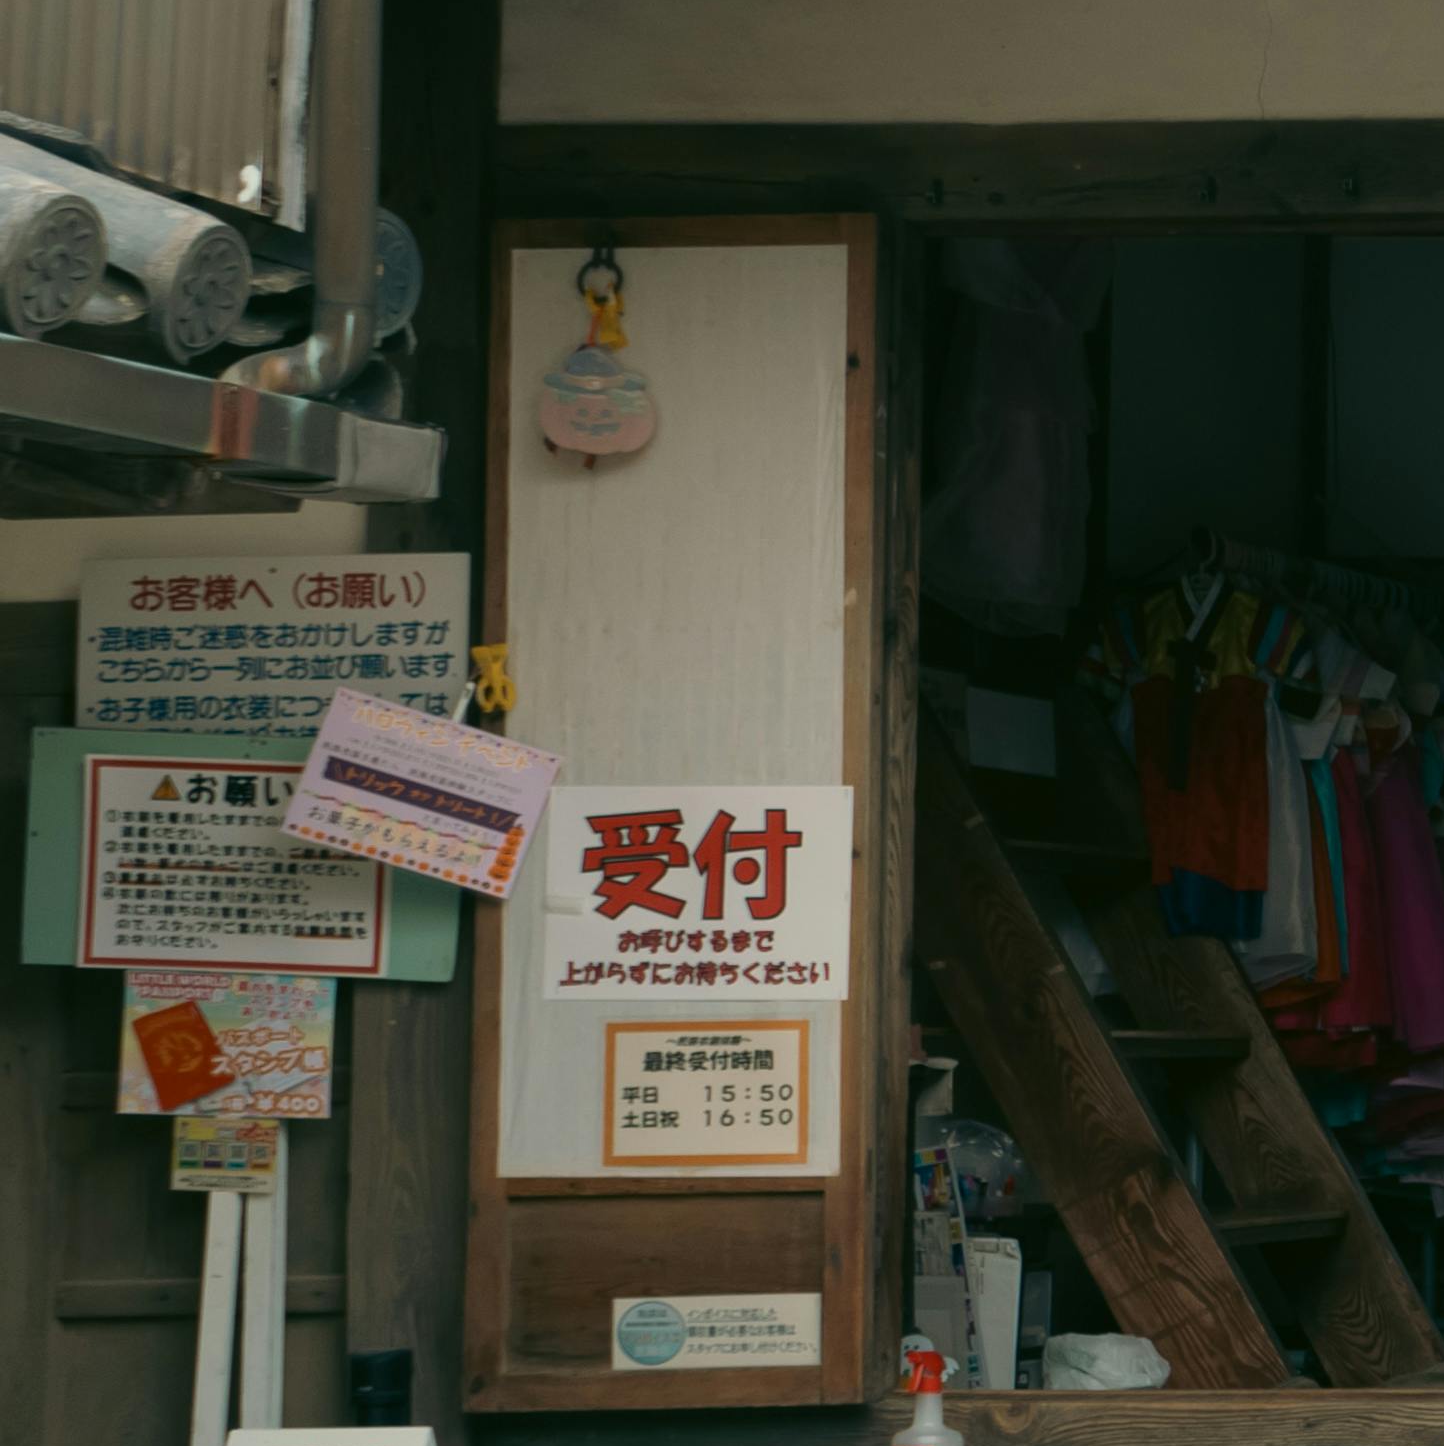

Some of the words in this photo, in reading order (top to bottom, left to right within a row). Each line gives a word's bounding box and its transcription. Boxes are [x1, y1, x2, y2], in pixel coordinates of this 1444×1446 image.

[581, 809, 803, 919] 受付
[617, 929, 775, 954] お呼びするまで
[559, 960, 830, 987] 上がらずにお待ちください
[643, 1050, 774, 1072] 最終受付時間
[621, 1086, 659, 1104] 平日
[621, 1110, 680, 1128] 土日祝
